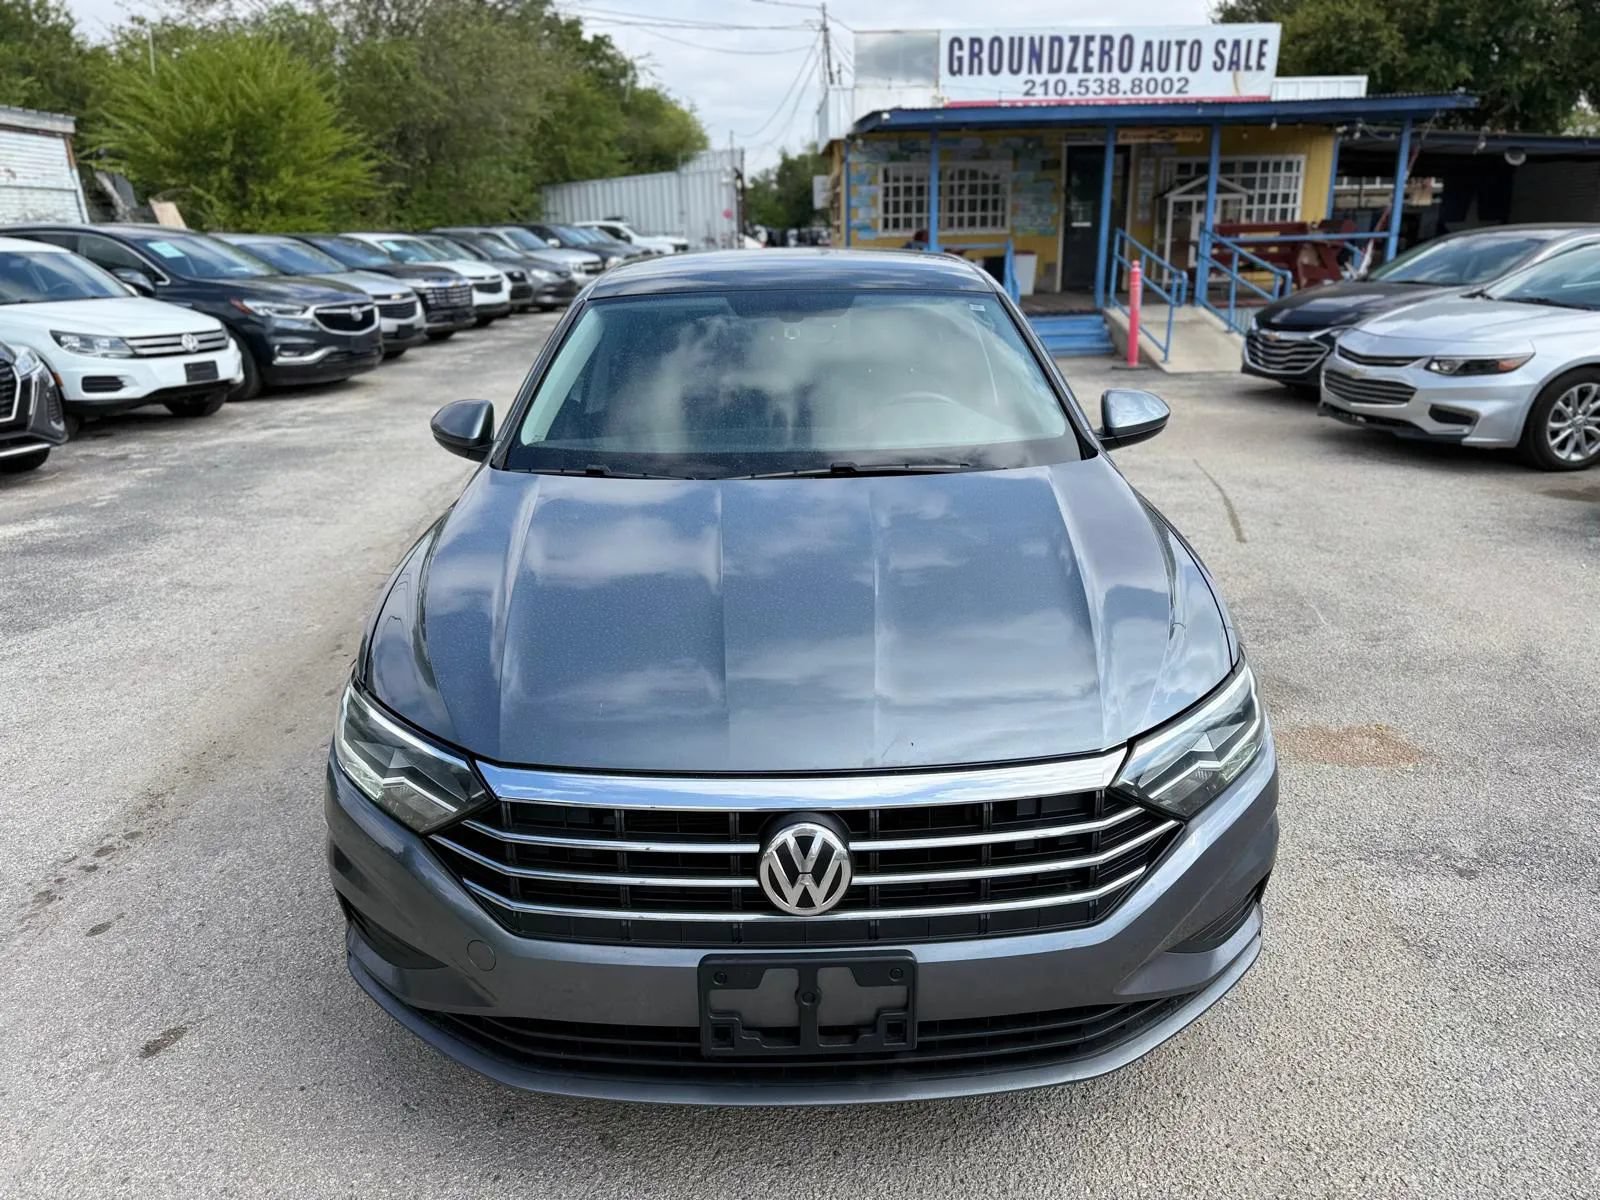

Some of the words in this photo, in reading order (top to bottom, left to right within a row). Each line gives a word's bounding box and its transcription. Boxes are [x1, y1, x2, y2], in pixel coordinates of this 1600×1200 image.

[948, 34, 1134, 76] GROUNDZERO
[1140, 39, 1203, 73] AUTO
[1212, 38, 1269, 72] SALE
[1023, 76, 1190, 98] 210.538.8002
[762, 825, 849, 914] VW
